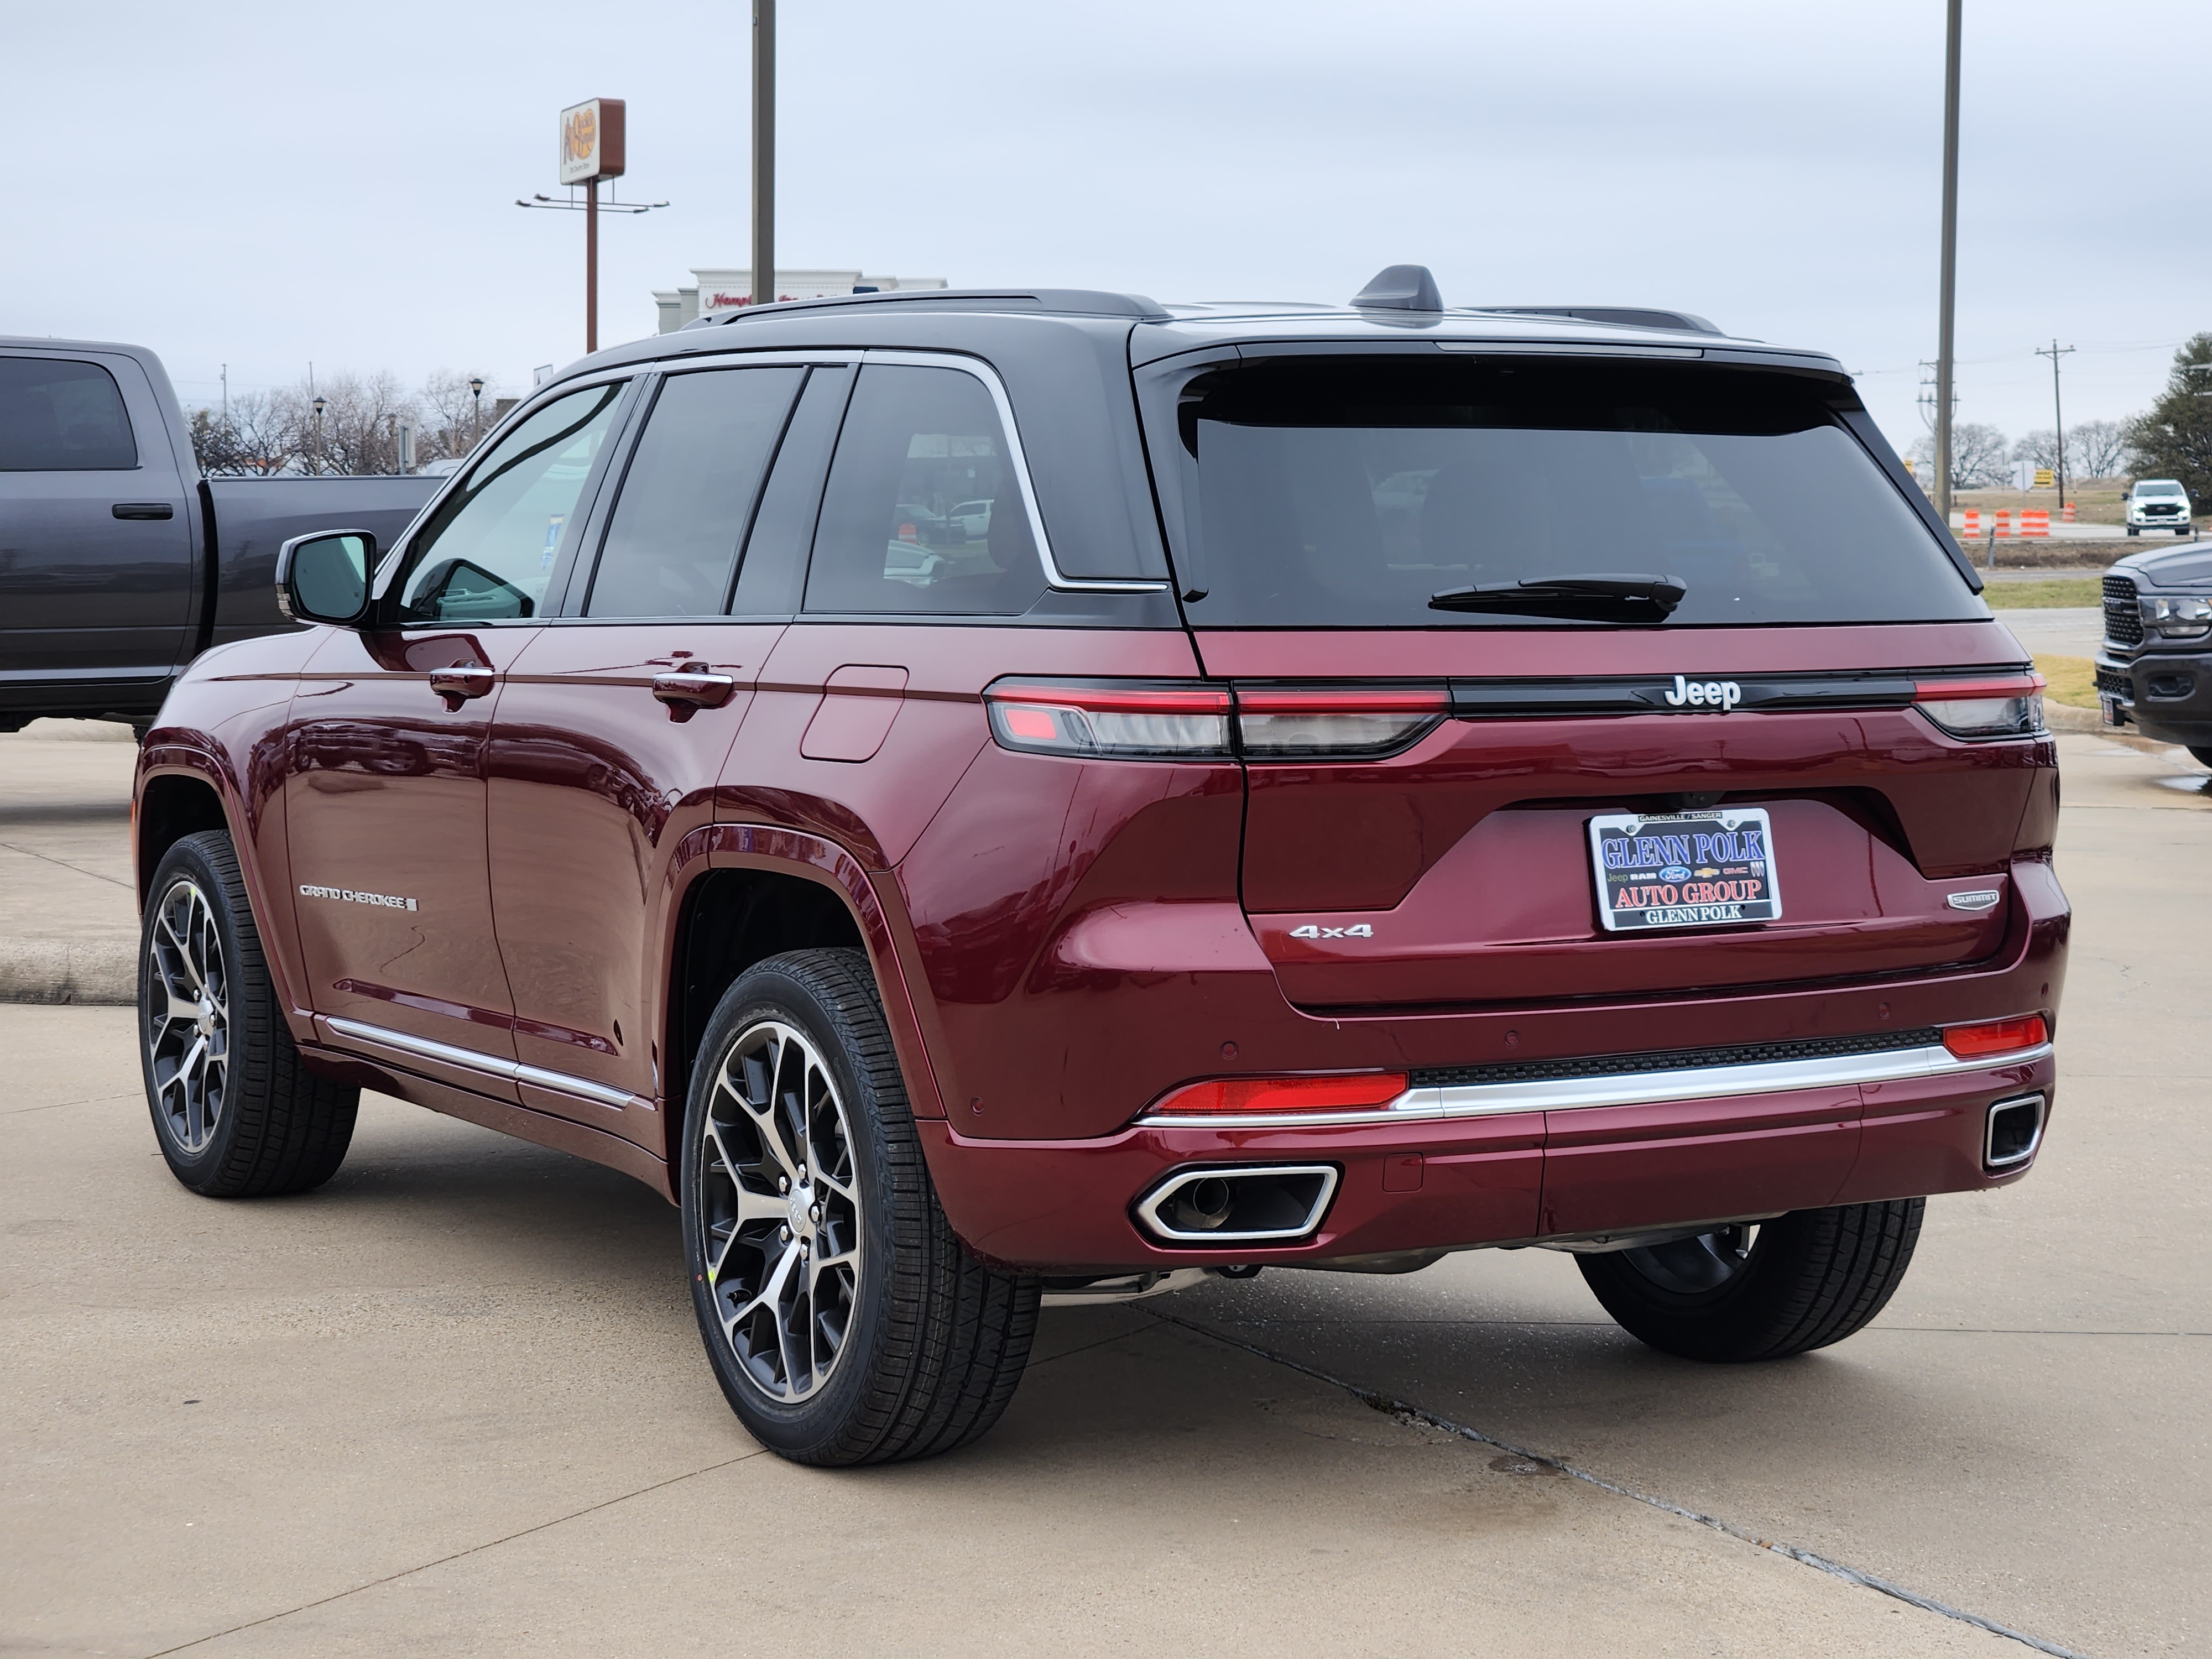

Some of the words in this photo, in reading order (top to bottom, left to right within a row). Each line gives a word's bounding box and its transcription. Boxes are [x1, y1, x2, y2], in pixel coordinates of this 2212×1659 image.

[706, 293, 752, 309] Hampt
[1665, 675, 1741, 711] Jeep
[1639, 813, 1686, 822] GAINESVILLE
[1601, 834, 1691, 869] GLENN
[1693, 830, 1765, 863] POLK
[1607, 873, 1629, 883] Jeep
[1630, 872, 1657, 880] RAM
[1665, 869, 1686, 880] Ford
[299, 885, 341, 900] GRAND
[342, 890, 406, 909] CHEROKEE
[1615, 884, 1678, 909] AUTO
[1682, 879, 1762, 904] GROUP
[1953, 893, 1996, 904] SUMMIT
[1646, 907, 1700, 924] GLENN
[1700, 905, 1743, 921] POLK
[1288, 924, 1374, 938] 4x4
